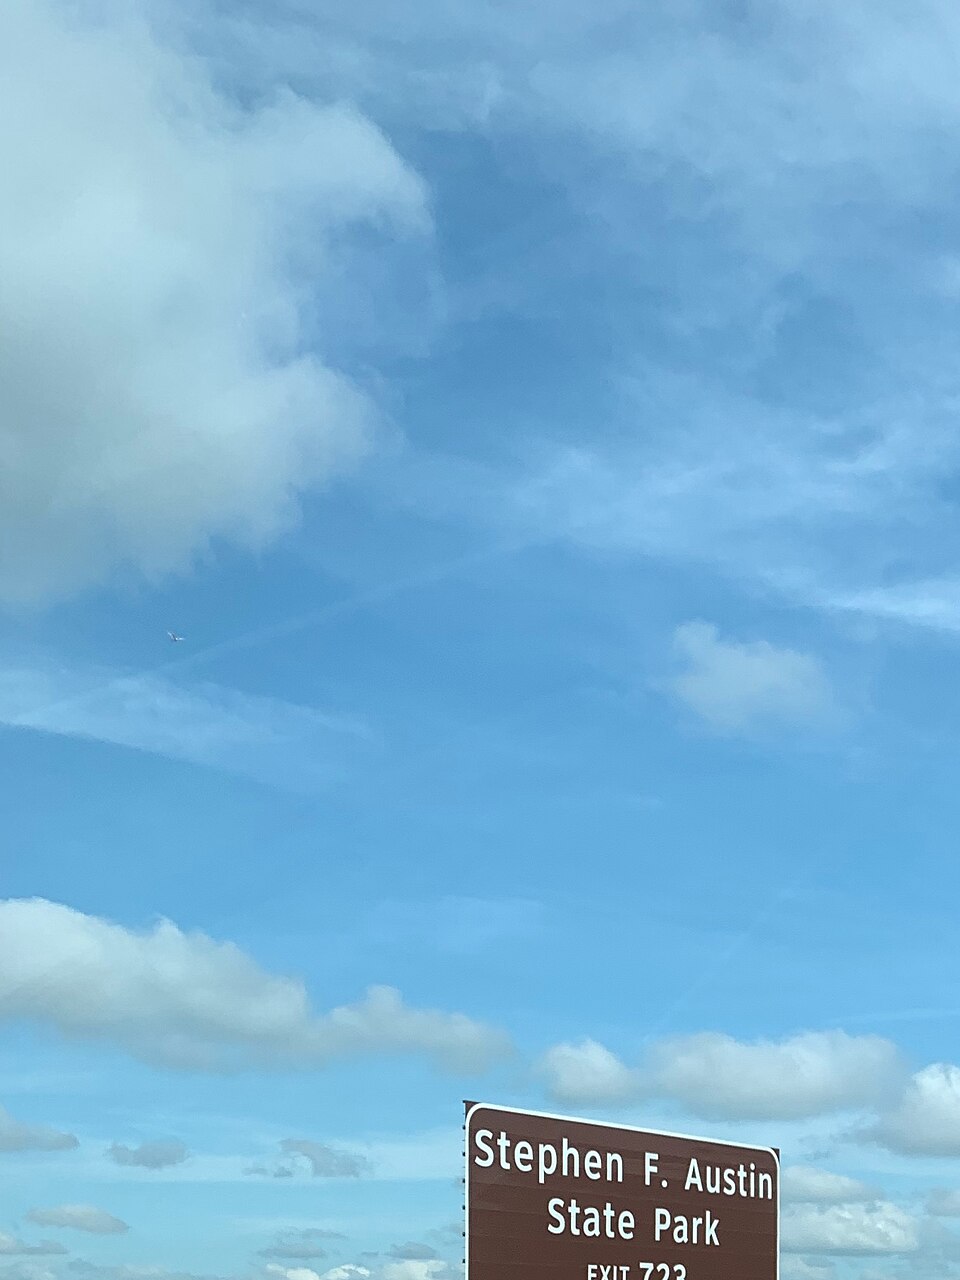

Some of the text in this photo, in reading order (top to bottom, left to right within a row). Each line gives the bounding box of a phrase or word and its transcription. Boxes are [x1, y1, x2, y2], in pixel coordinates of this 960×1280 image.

[474, 1129, 773, 1200] Stephen F. Austin
[547, 1197, 720, 1246] State Park
